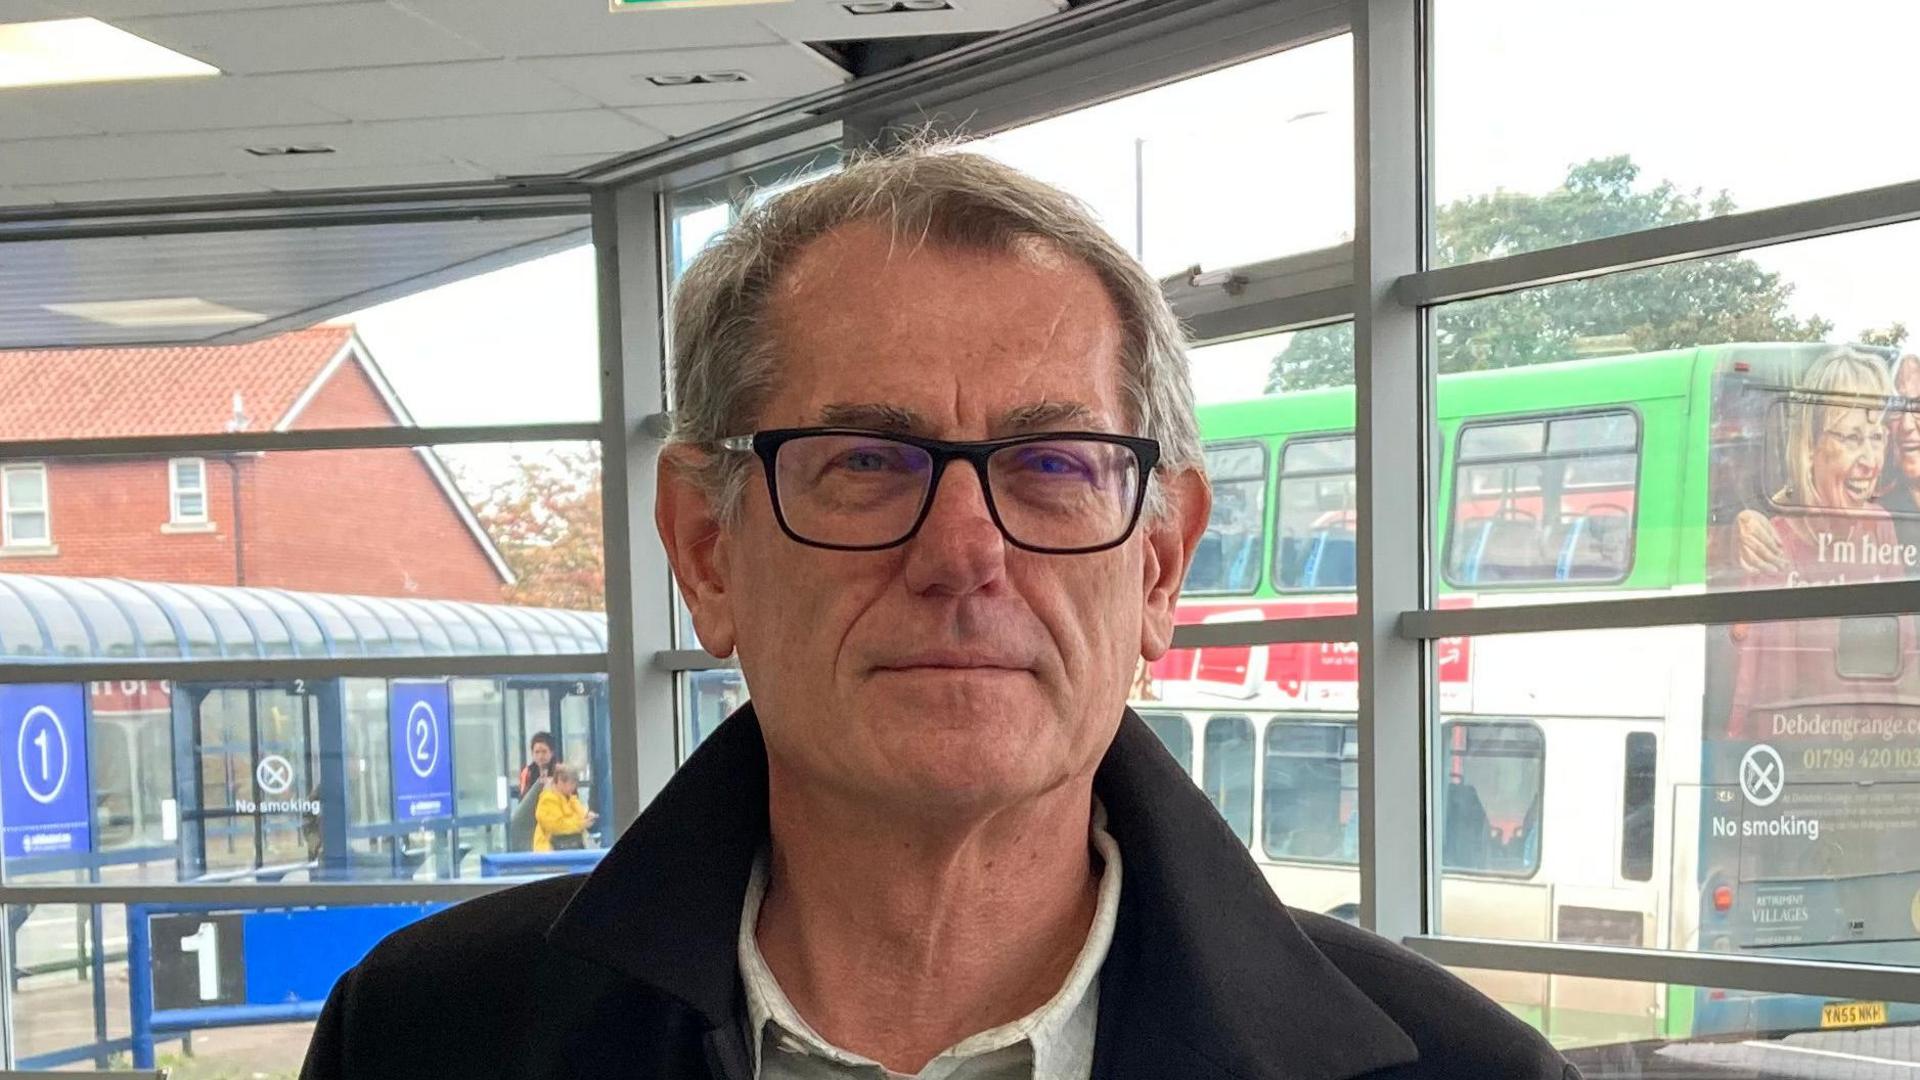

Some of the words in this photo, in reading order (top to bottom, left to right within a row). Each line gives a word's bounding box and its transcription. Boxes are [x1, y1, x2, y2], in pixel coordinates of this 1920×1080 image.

[1818, 532, 1856, 563] I'm
[1861, 534, 1918, 566] here
[294, 679, 305, 693] 2
[416, 718, 429, 760] 2
[1772, 713, 1920, 742] Debdengrange.c
[34, 728, 48, 781] 1
[235, 799, 256, 814] No
[259, 799, 320, 815] smoking
[1712, 816, 1737, 837] No
[1742, 815, 1819, 841] smoking
[1752, 907, 1808, 922] VILLAGES
[180, 922, 217, 1001] 1
